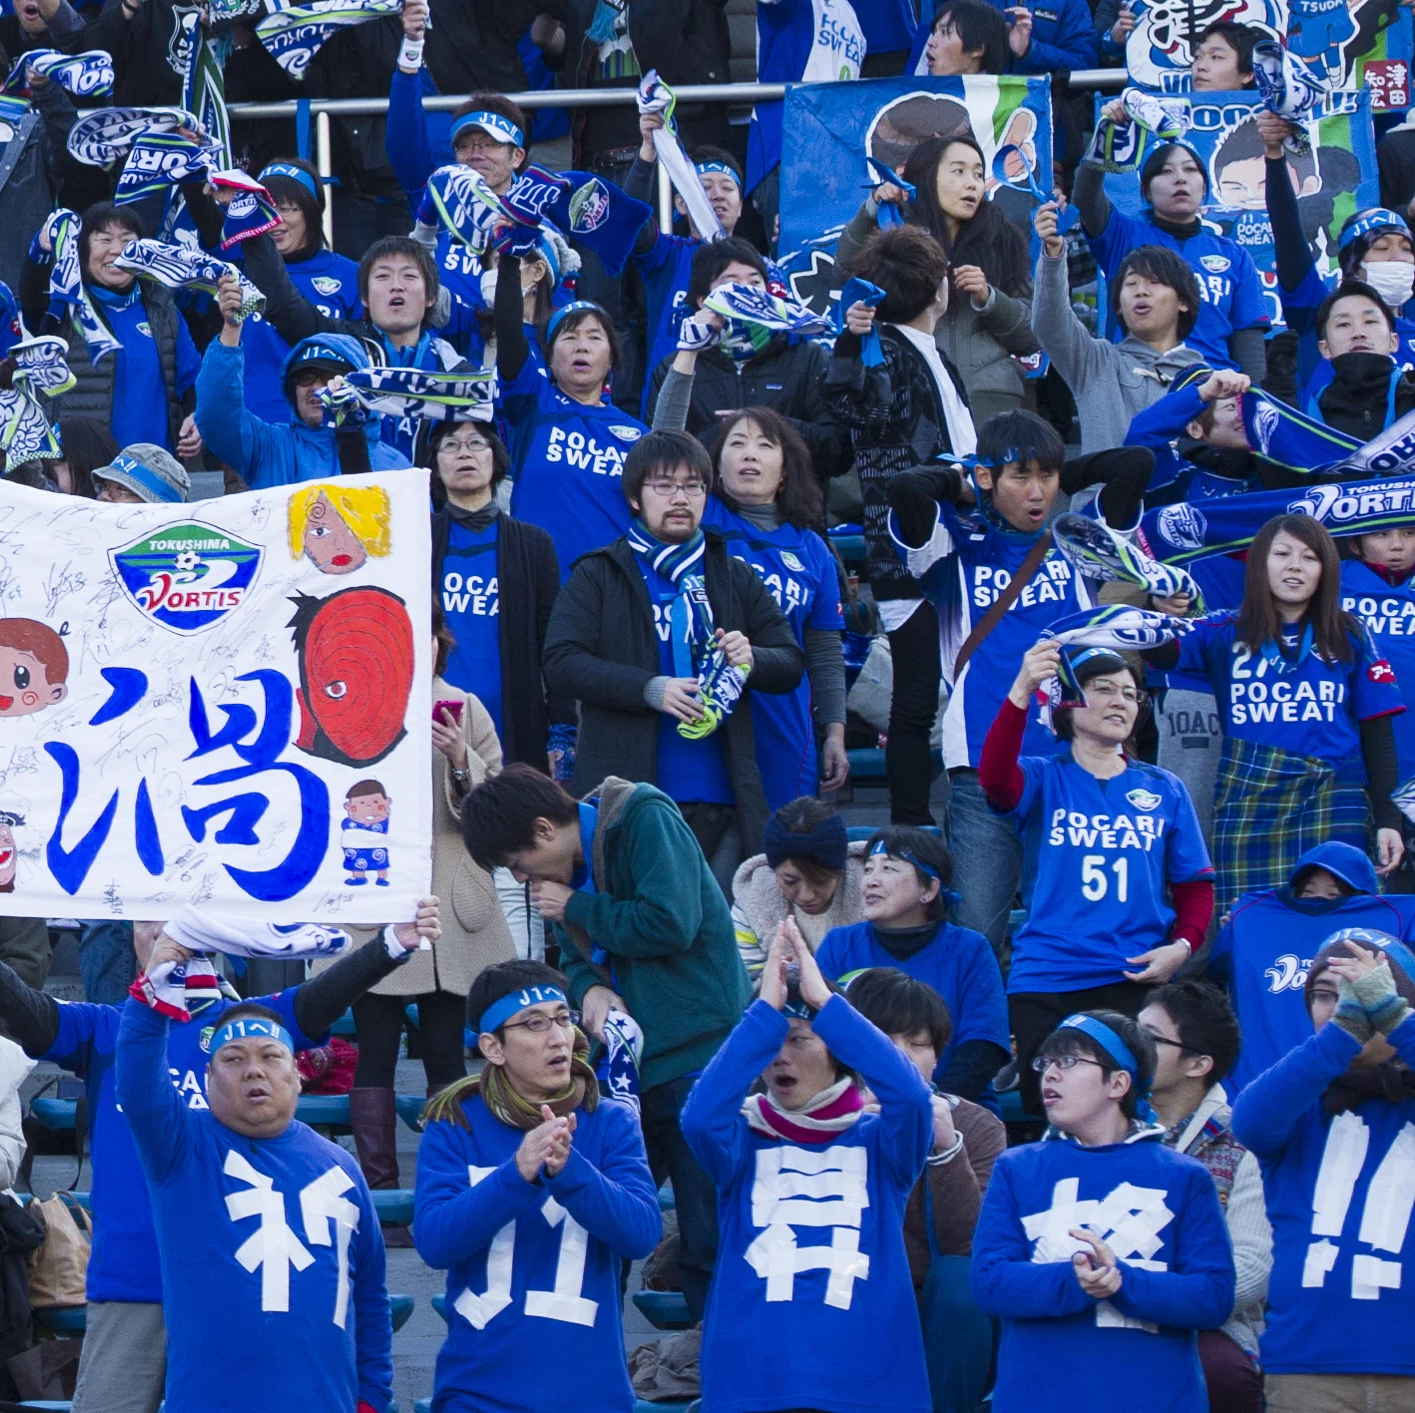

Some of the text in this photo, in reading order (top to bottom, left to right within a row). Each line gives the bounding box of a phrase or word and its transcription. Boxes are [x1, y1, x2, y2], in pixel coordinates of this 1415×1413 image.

[148, 538, 231, 553] TOKUSHIMA
[140, 573, 242, 612] VORTIS
[1230, 680, 1346, 705] POCARI
[1231, 700, 1337, 725] SWEAT
[1052, 807, 1165, 842] POCARI
[1048, 825, 1158, 854] SWEAT
[1080, 854, 1129, 904] 51
[223, 1019, 283, 1042] J1へ!!
